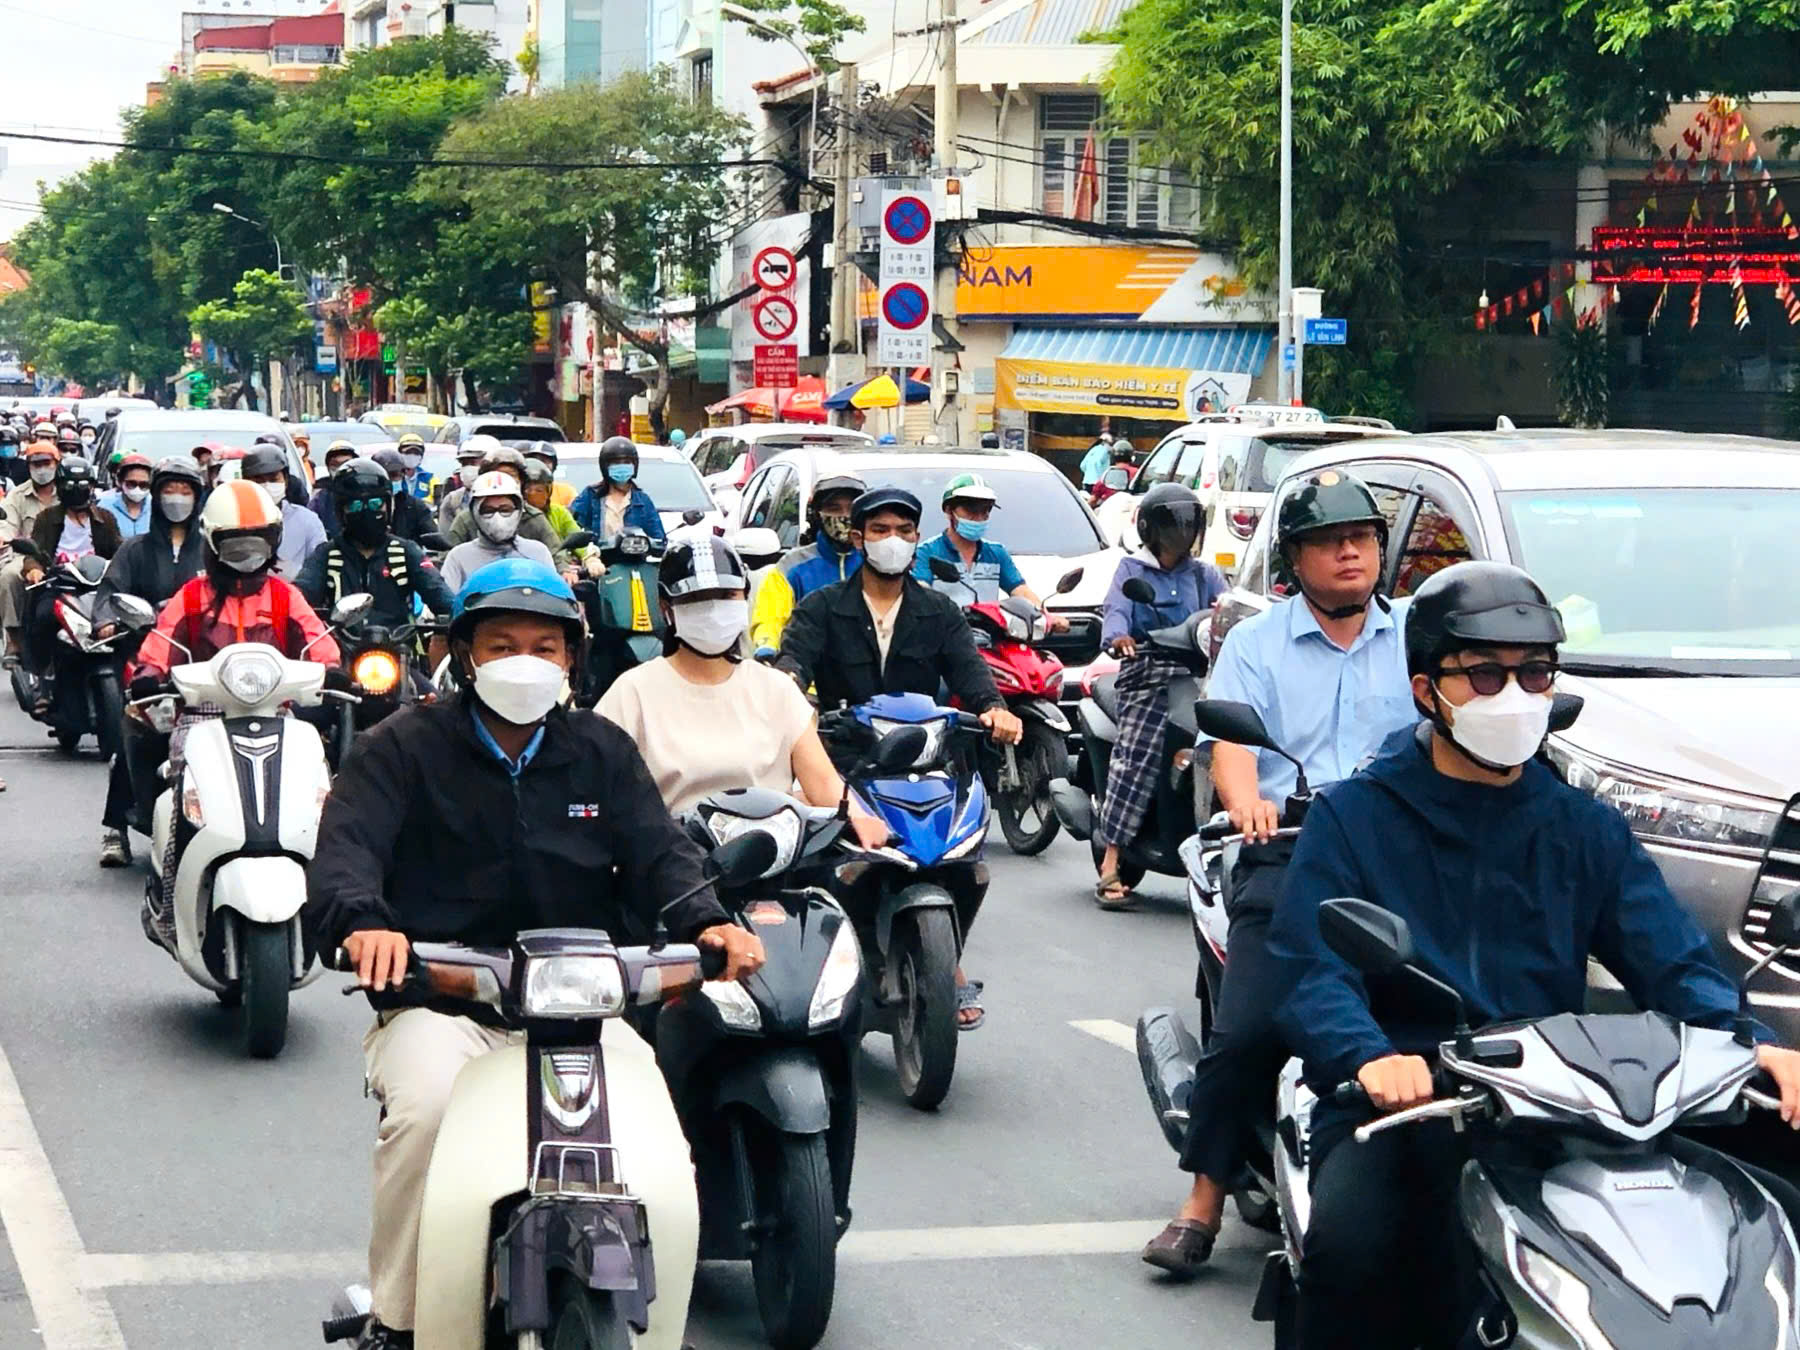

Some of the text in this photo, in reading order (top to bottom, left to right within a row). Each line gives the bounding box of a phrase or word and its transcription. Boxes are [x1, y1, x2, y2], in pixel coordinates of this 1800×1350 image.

[955, 265, 1032, 287] NAM
[1286, 412, 1301, 422] 27
[1305, 413, 1319, 423] 27
